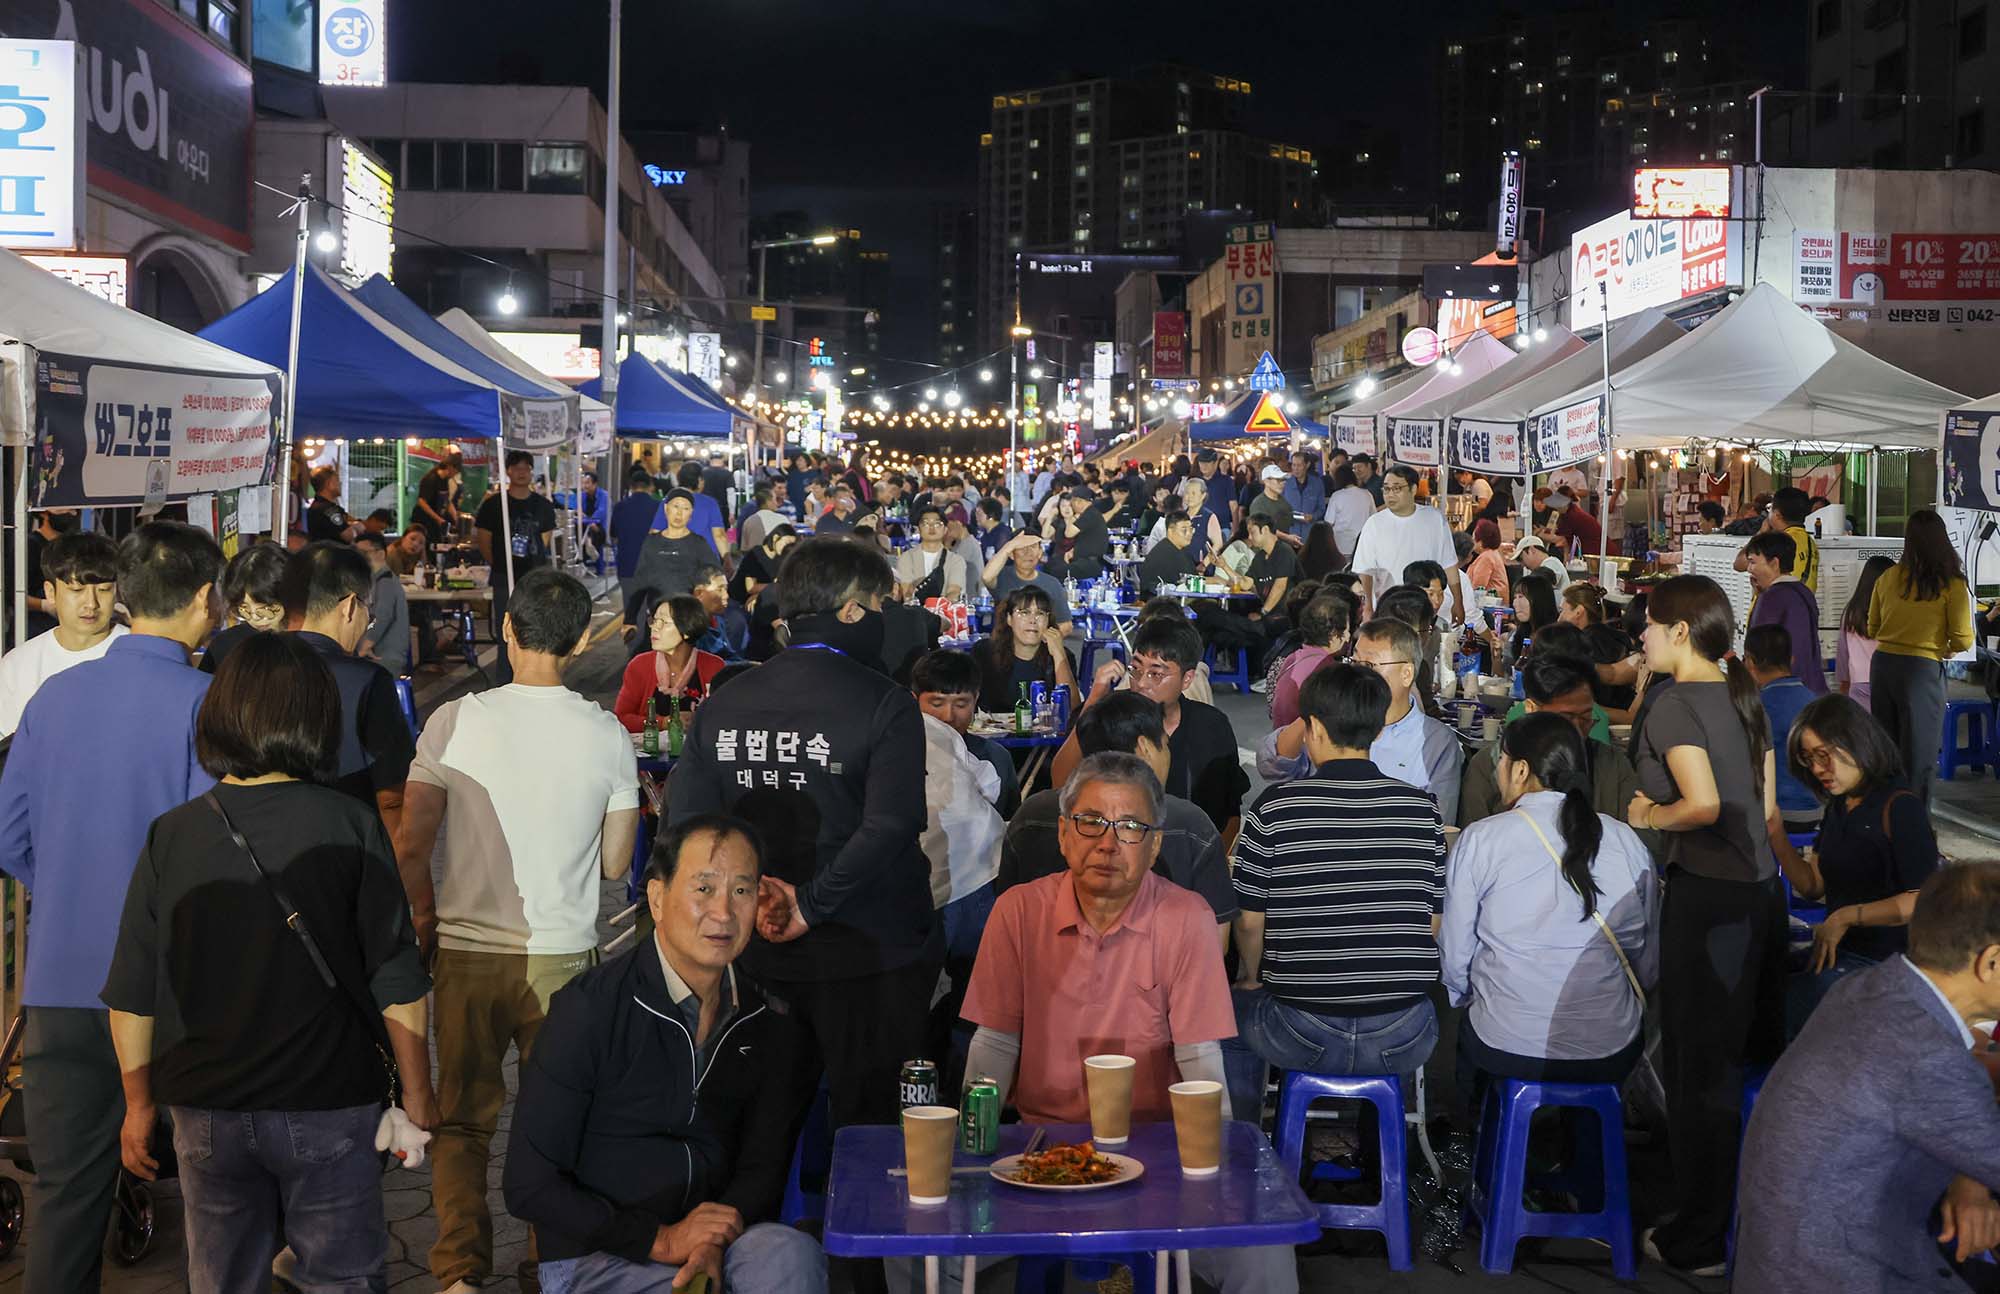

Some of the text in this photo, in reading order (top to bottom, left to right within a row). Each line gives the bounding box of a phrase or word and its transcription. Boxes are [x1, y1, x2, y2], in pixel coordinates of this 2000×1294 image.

[331, 15, 367, 50] 장
[337, 63, 360, 80] 3F
[177, 138, 209, 184] 아우디
[643, 164, 687, 187] SKY
[1801, 238, 1832, 248] 간편해서
[1853, 238, 1887, 249] HELLO
[1226, 242, 1273, 280] 부동산
[1801, 248, 1832, 259] 좋으니까
[1081, 260, 1092, 272] H
[1801, 265, 1832, 276] 매일매일
[1800, 276, 1832, 287] 깨끗하게
[1888, 308, 1940, 322] 신탄진점
[1231, 318, 1271, 339] 컨설팅
[715, 728, 831, 767] 불법단속
[736, 768, 807, 791] 대덕구
[900, 1082, 937, 1104] ERRA
